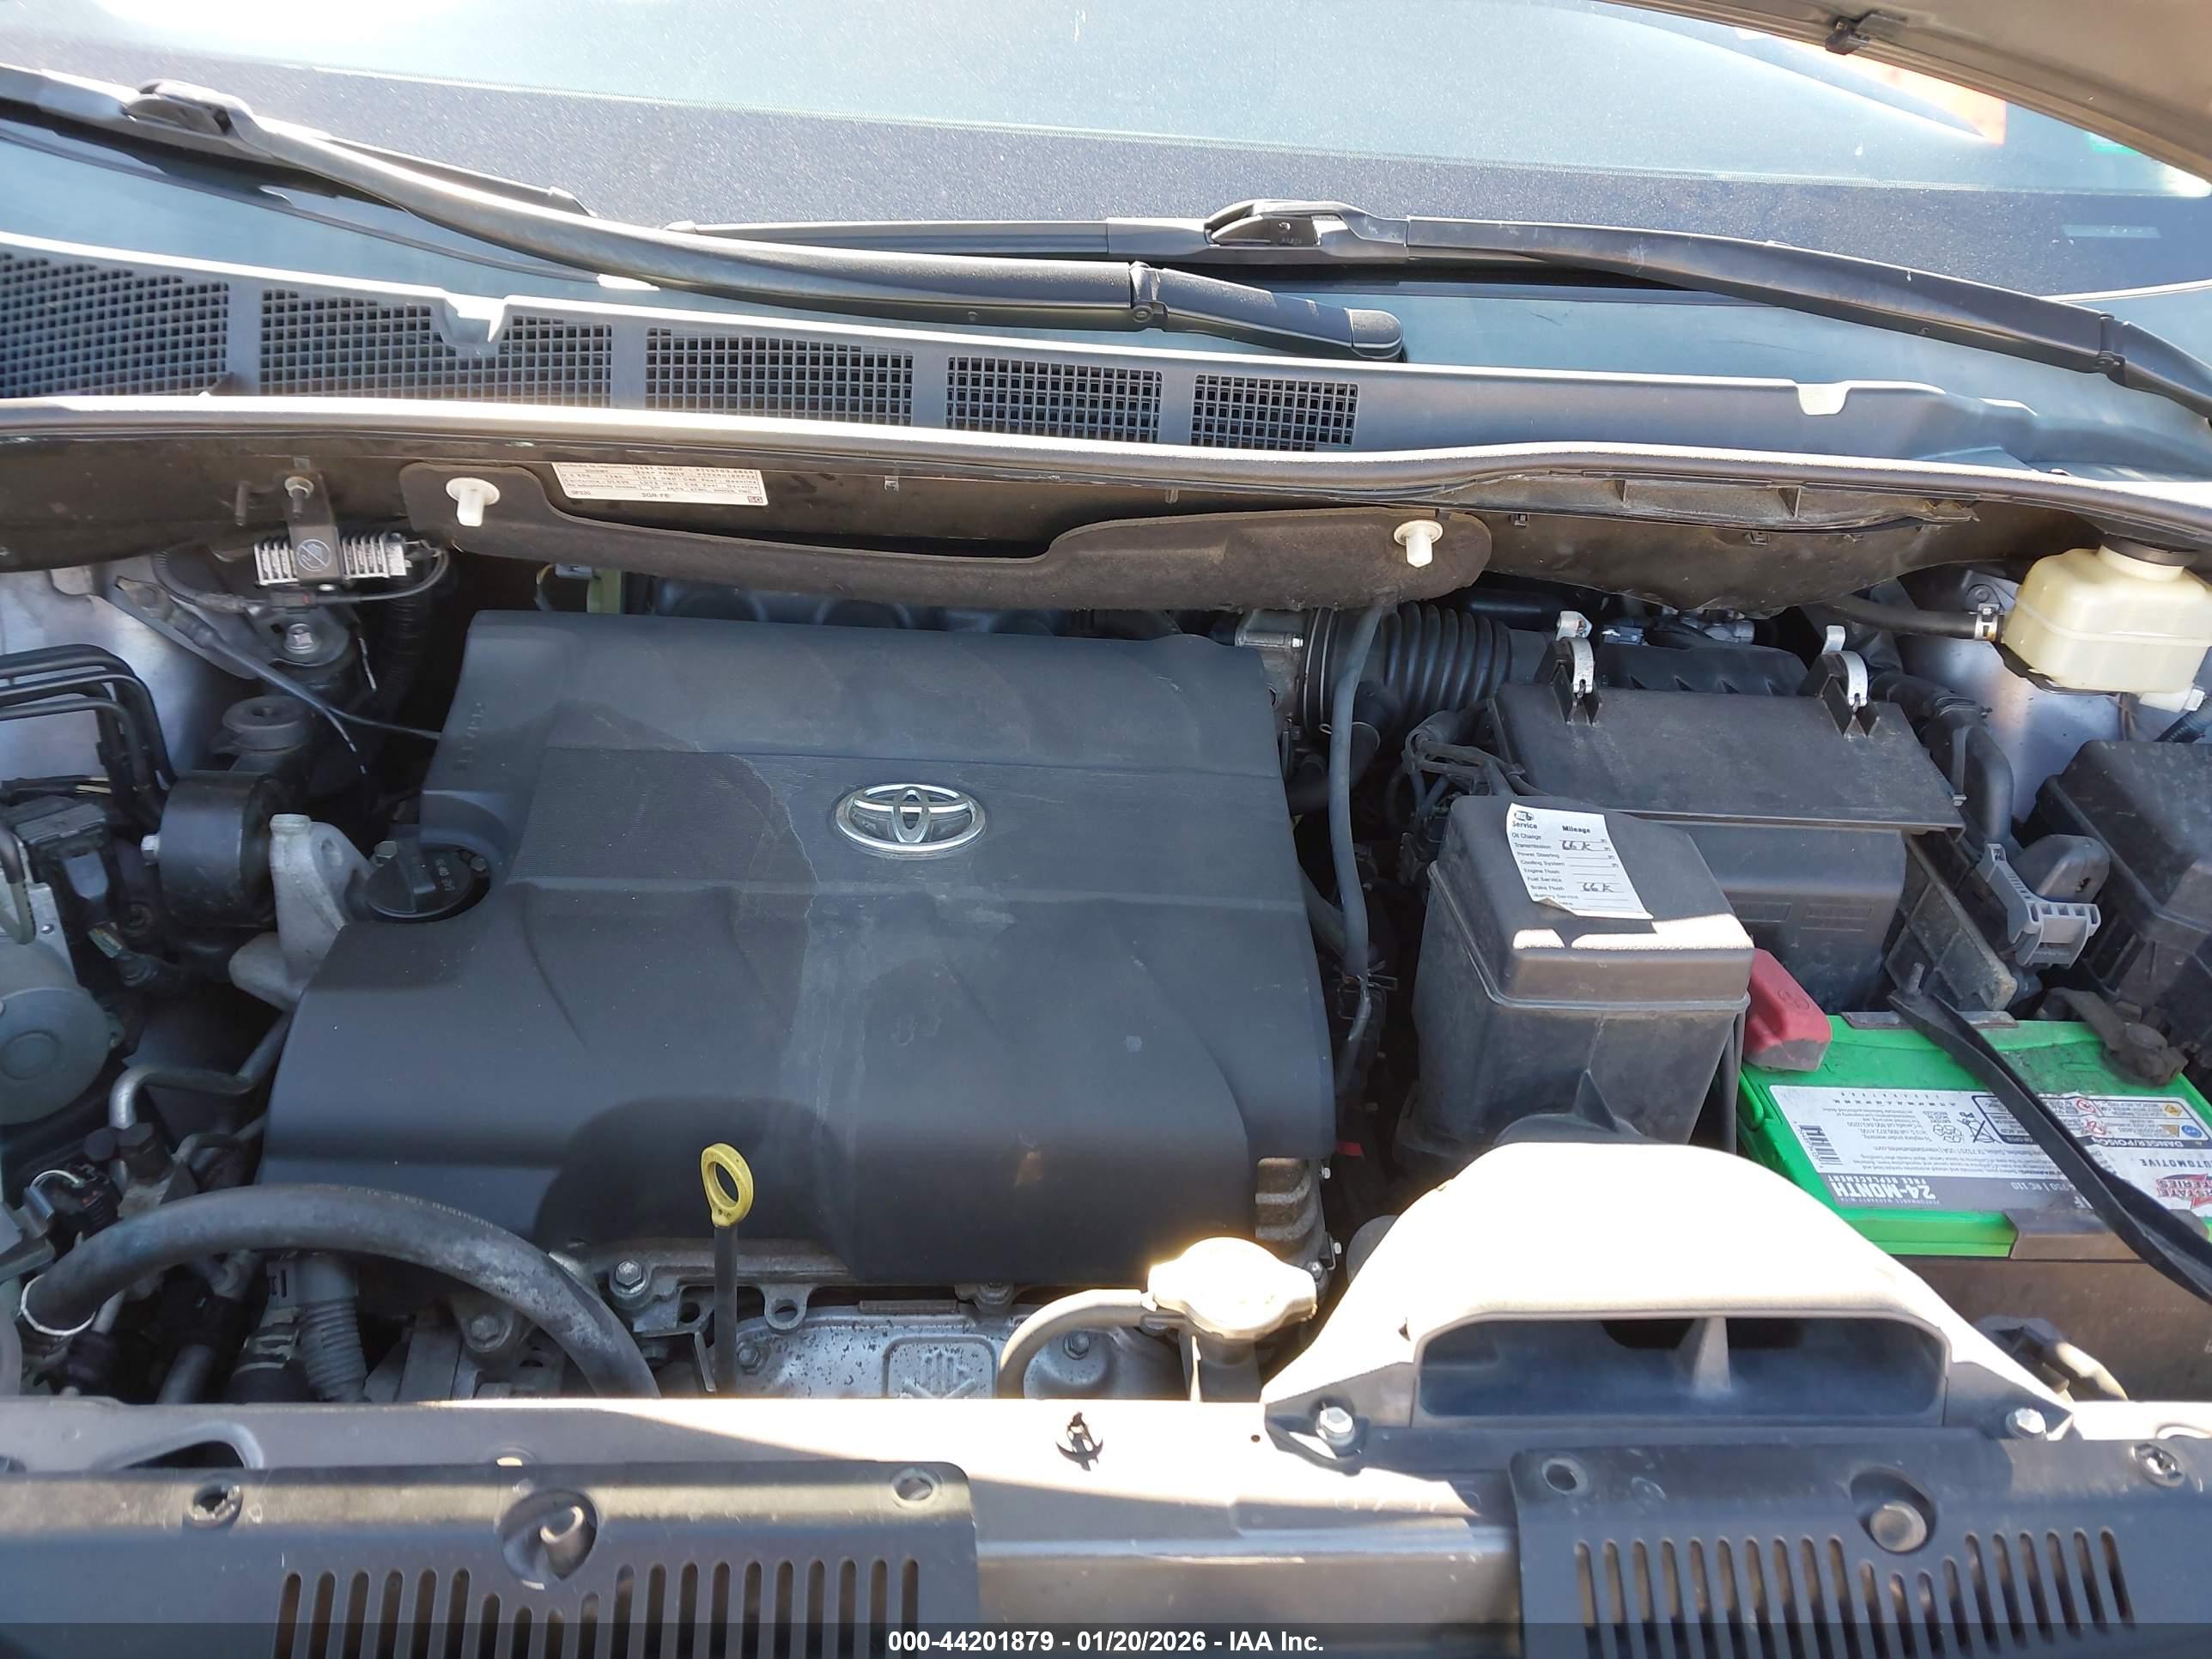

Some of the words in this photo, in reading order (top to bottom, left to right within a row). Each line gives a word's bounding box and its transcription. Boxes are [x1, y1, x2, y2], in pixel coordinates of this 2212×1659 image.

[1562, 825, 1590, 834] Mileage
[1827, 1175, 1899, 1183] REPLACEMENT
[1830, 1182, 1936, 1200] 24-MONTH
